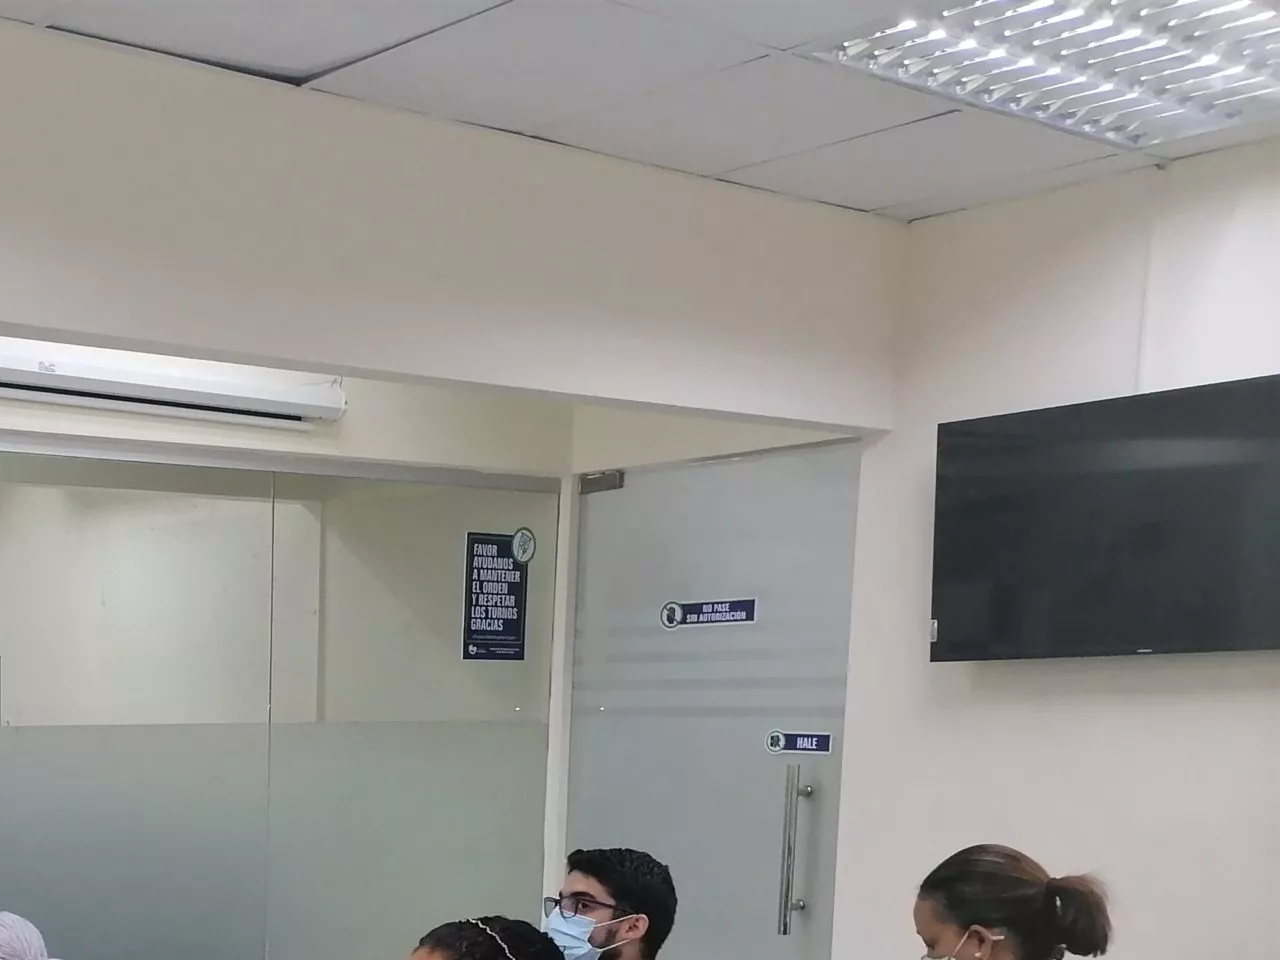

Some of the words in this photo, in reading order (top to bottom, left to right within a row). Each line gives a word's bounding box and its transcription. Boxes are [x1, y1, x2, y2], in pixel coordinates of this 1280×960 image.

[473, 543, 498, 557] FAVOR
[472, 568, 478, 580] A
[480, 569, 520, 582] MANTENER
[472, 581, 481, 593] EL
[482, 581, 508, 594] ORDEN
[471, 594, 477, 606] Y
[478, 594, 516, 607] RESPETAR
[471, 606, 486, 618] LOS
[488, 606, 519, 619] TURNOS
[702, 604, 712, 613] NO
[713, 603, 730, 612] PASE
[470, 619, 504, 631] GRACIAS
[686, 614, 698, 623] SIN
[796, 737, 818, 749] HALE
